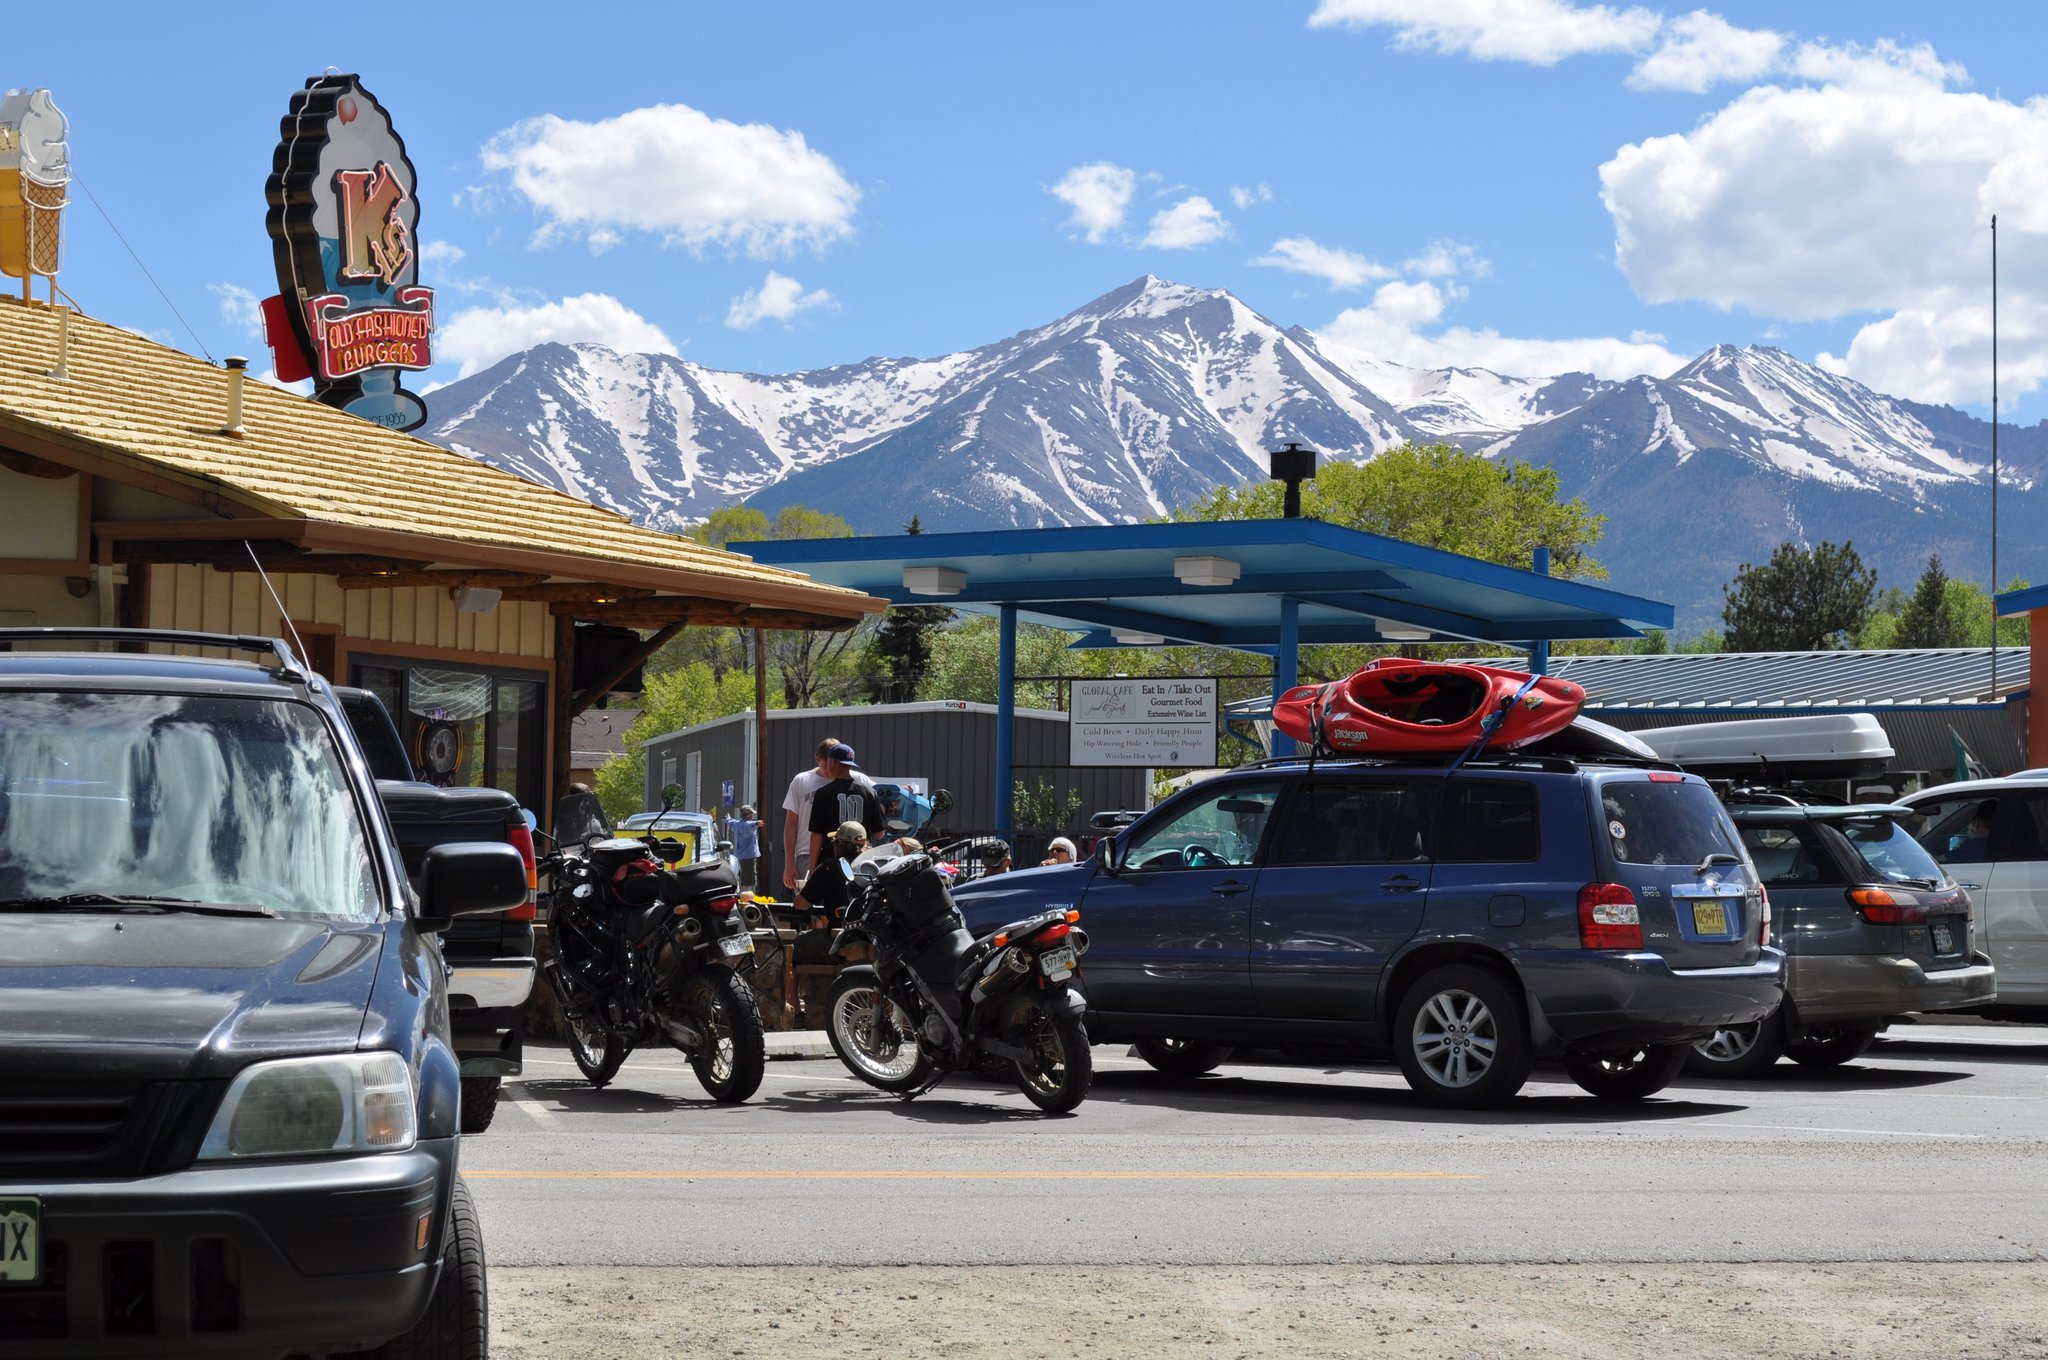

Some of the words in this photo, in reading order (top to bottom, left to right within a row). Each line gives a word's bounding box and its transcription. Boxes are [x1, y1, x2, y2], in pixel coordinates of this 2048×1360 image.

[329, 322, 354, 349] OLD
[355, 313, 427, 340] FASHIONED
[342, 342, 418, 372] BURGERS
[386, 411, 406, 426] 1955
[1081, 686, 1109, 696] GLOBAL
[1142, 684, 1155, 694] Eat
[1157, 684, 1165, 694] In
[1174, 683, 1193, 694] Take
[1194, 684, 1212, 694] Out
[945, 702, 960, 710] Kirby
[1150, 697, 1183, 706] Gourmet
[1185, 697, 1203, 706] Food
[1147, 709, 1177, 717] Extensive
[1177, 709, 1194, 717] Wine
[1195, 709, 1208, 717] List
[1083, 727, 1101, 735] Cold
[1134, 727, 1154, 738] Daily
[1157, 727, 1180, 738] Happy
[1183, 727, 1204, 735] Hour
[1083, 740, 1095, 749] Hip
[1096, 740, 1125, 749] Watering
[1153, 740, 1179, 749] Friendly
[1181, 740, 1204, 748] People
[1147, 753, 1162, 761] Spot
[836, 793, 864, 824] 10
